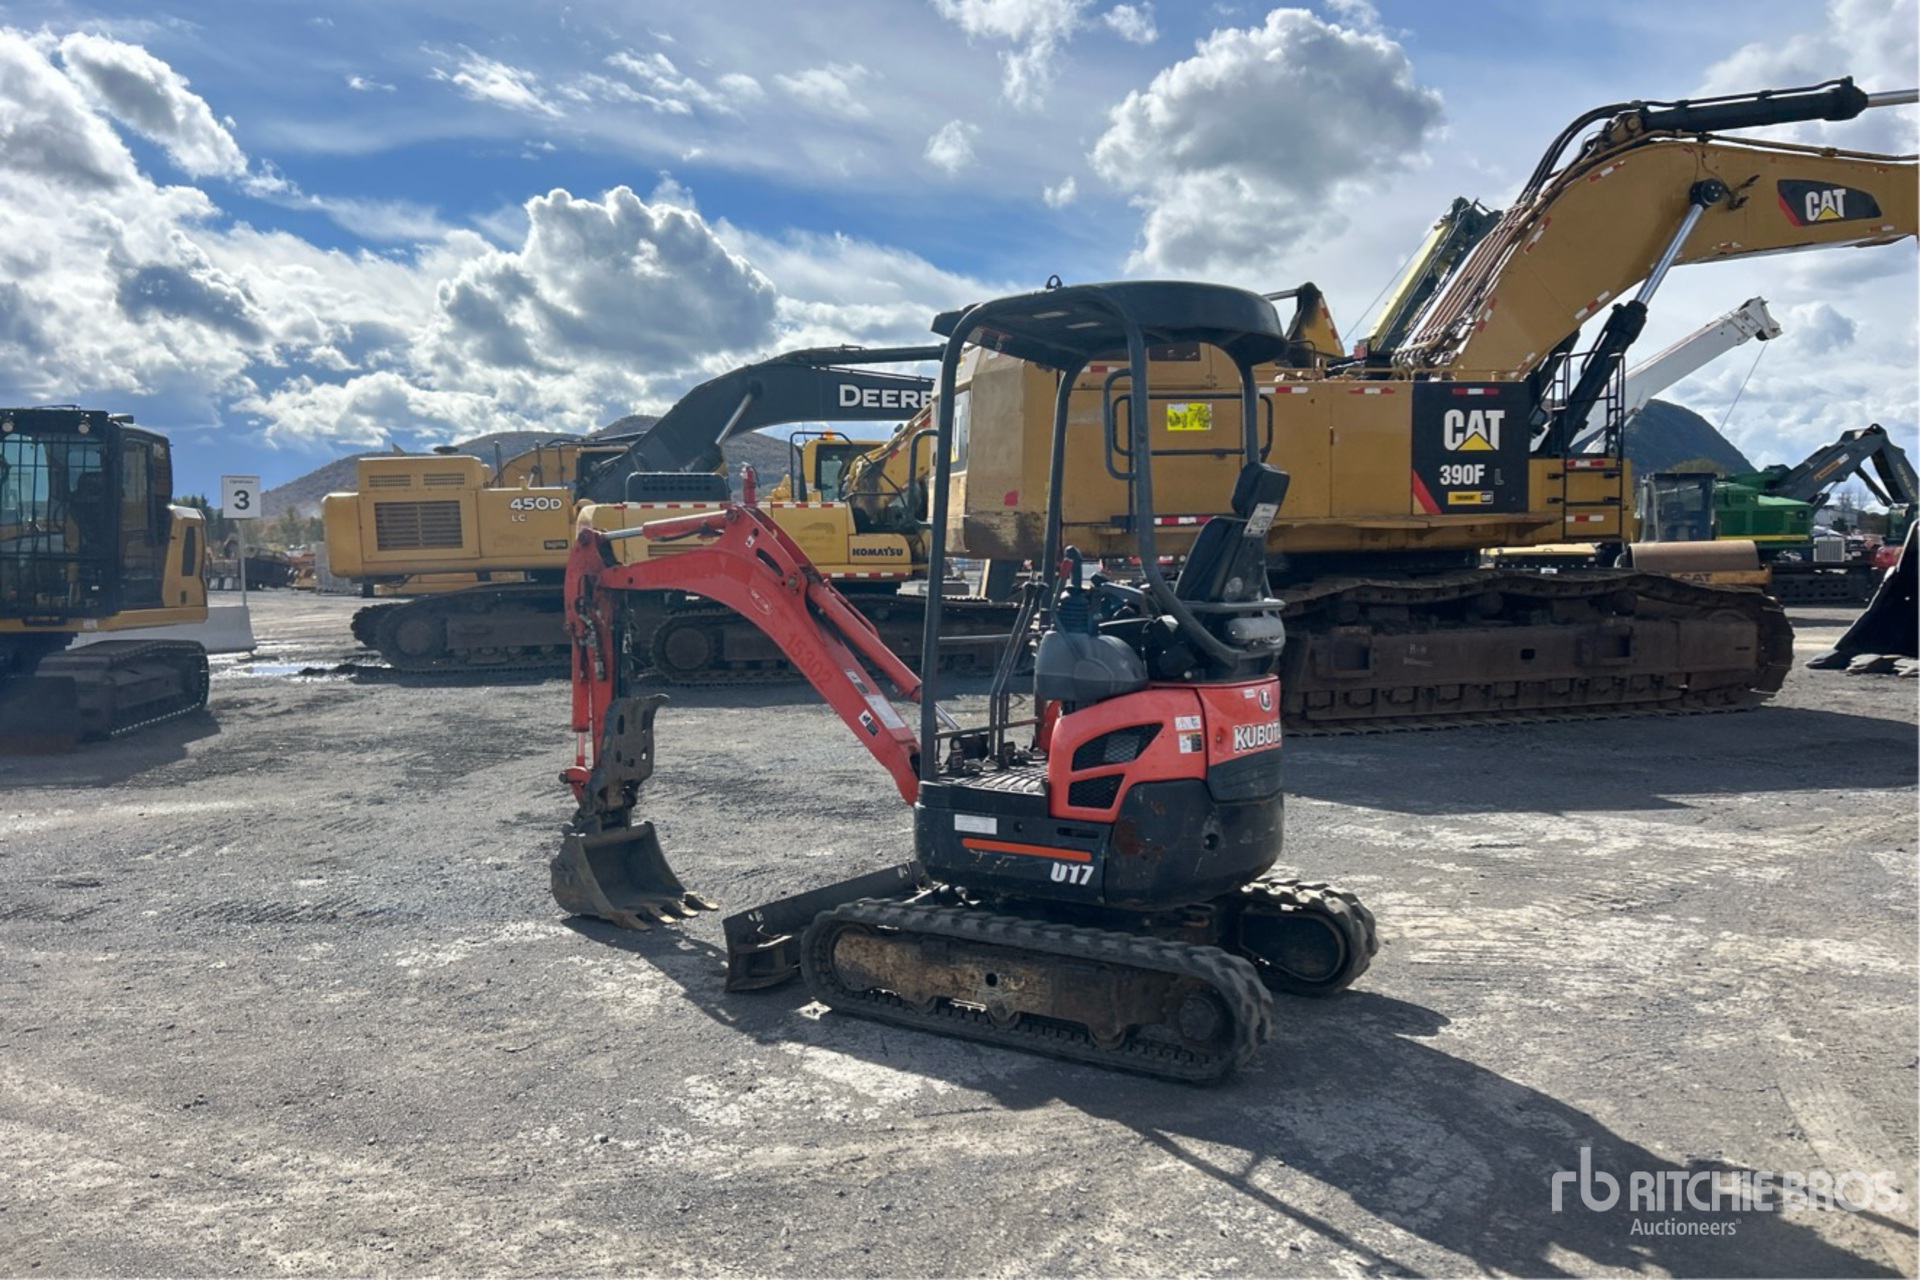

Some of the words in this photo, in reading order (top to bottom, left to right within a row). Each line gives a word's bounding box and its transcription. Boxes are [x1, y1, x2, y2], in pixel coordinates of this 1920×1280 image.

[1805, 188, 1846, 221] CAT
[1444, 409, 1505, 451] CAT
[1440, 464, 1485, 485] 390F
[234, 490, 250, 510] 3
[510, 497, 562, 510] 450D
[511, 514, 526, 522] LC
[852, 547, 903, 556] KOMATSU
[1233, 721, 1281, 751] KUBOT
[1050, 862, 1094, 885] U17
